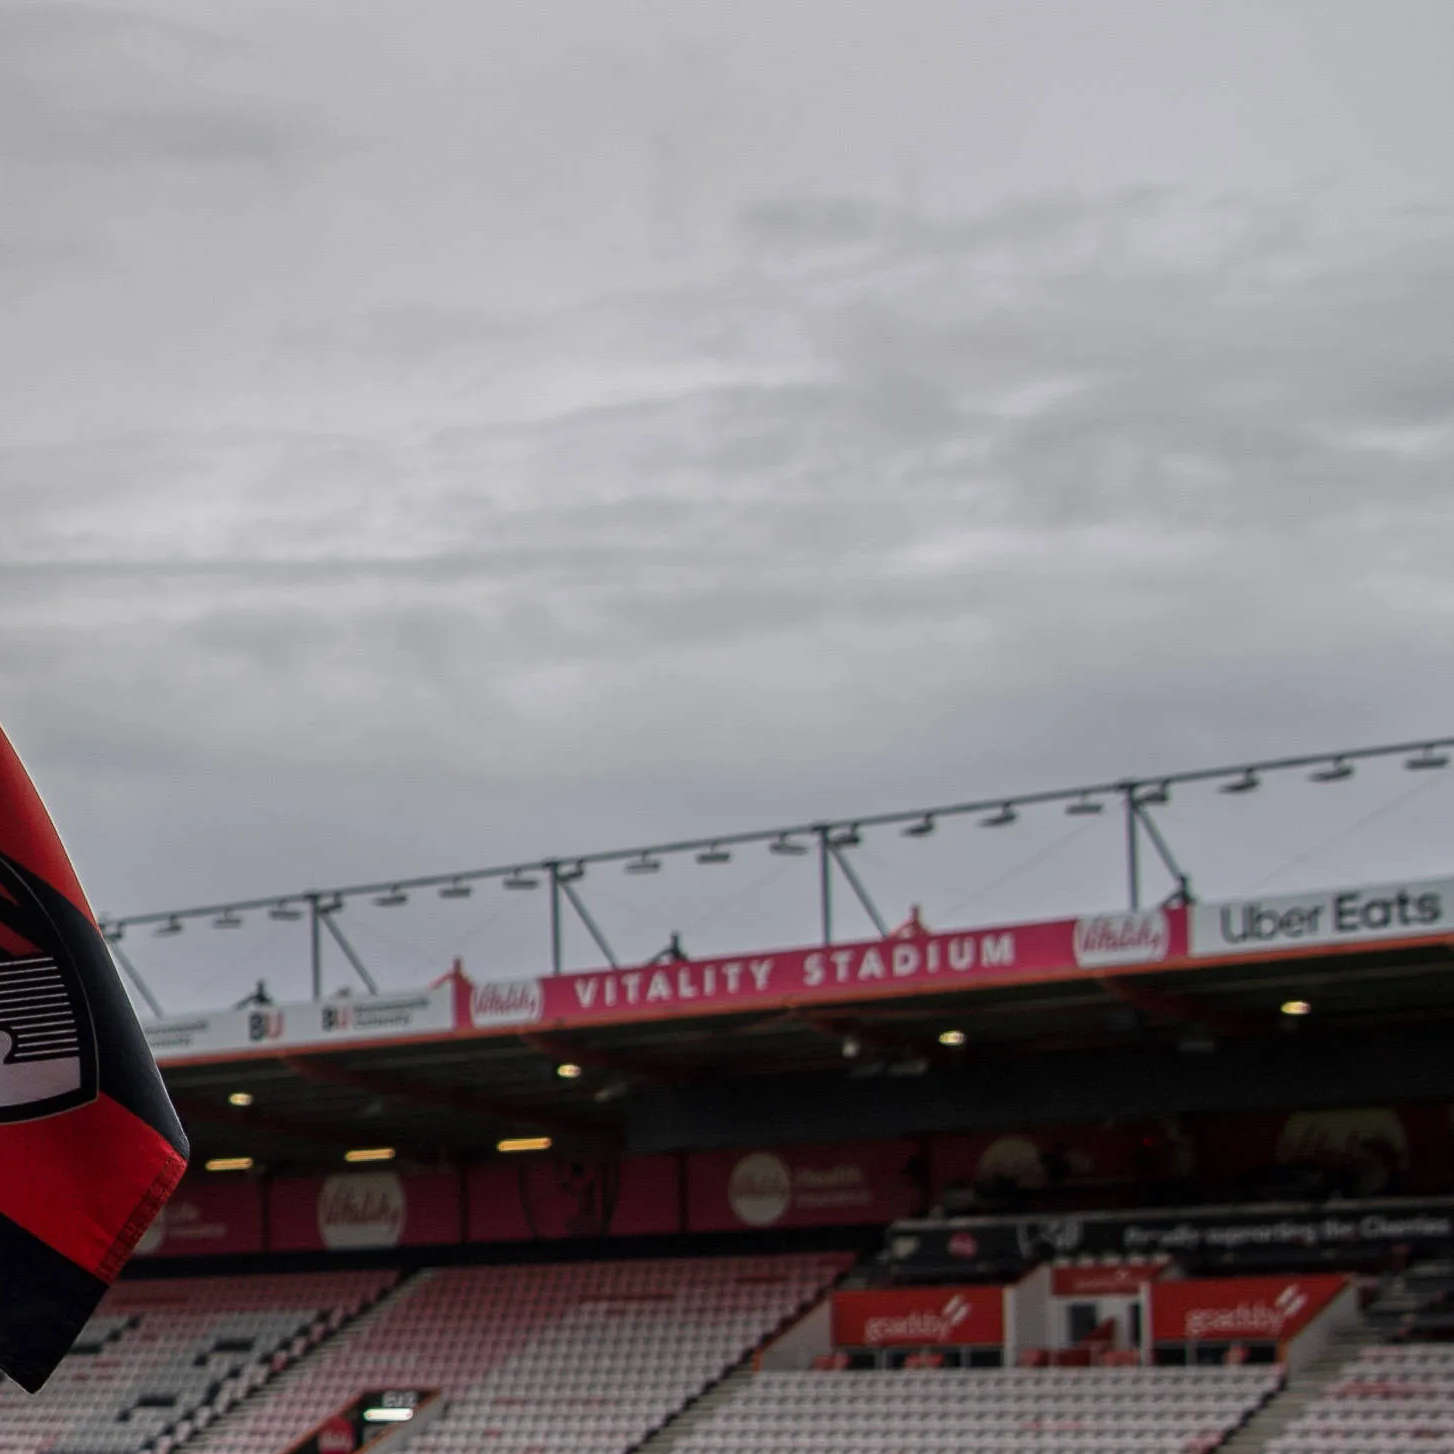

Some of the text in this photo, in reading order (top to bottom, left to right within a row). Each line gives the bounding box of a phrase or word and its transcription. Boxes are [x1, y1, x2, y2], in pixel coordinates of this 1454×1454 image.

[1220, 890, 1442, 943] Uber Eats
[574, 932, 1015, 1008] VITALITY STADIUM
[475, 978, 539, 1020] Vitality
[248, 1009, 285, 1043] BU
